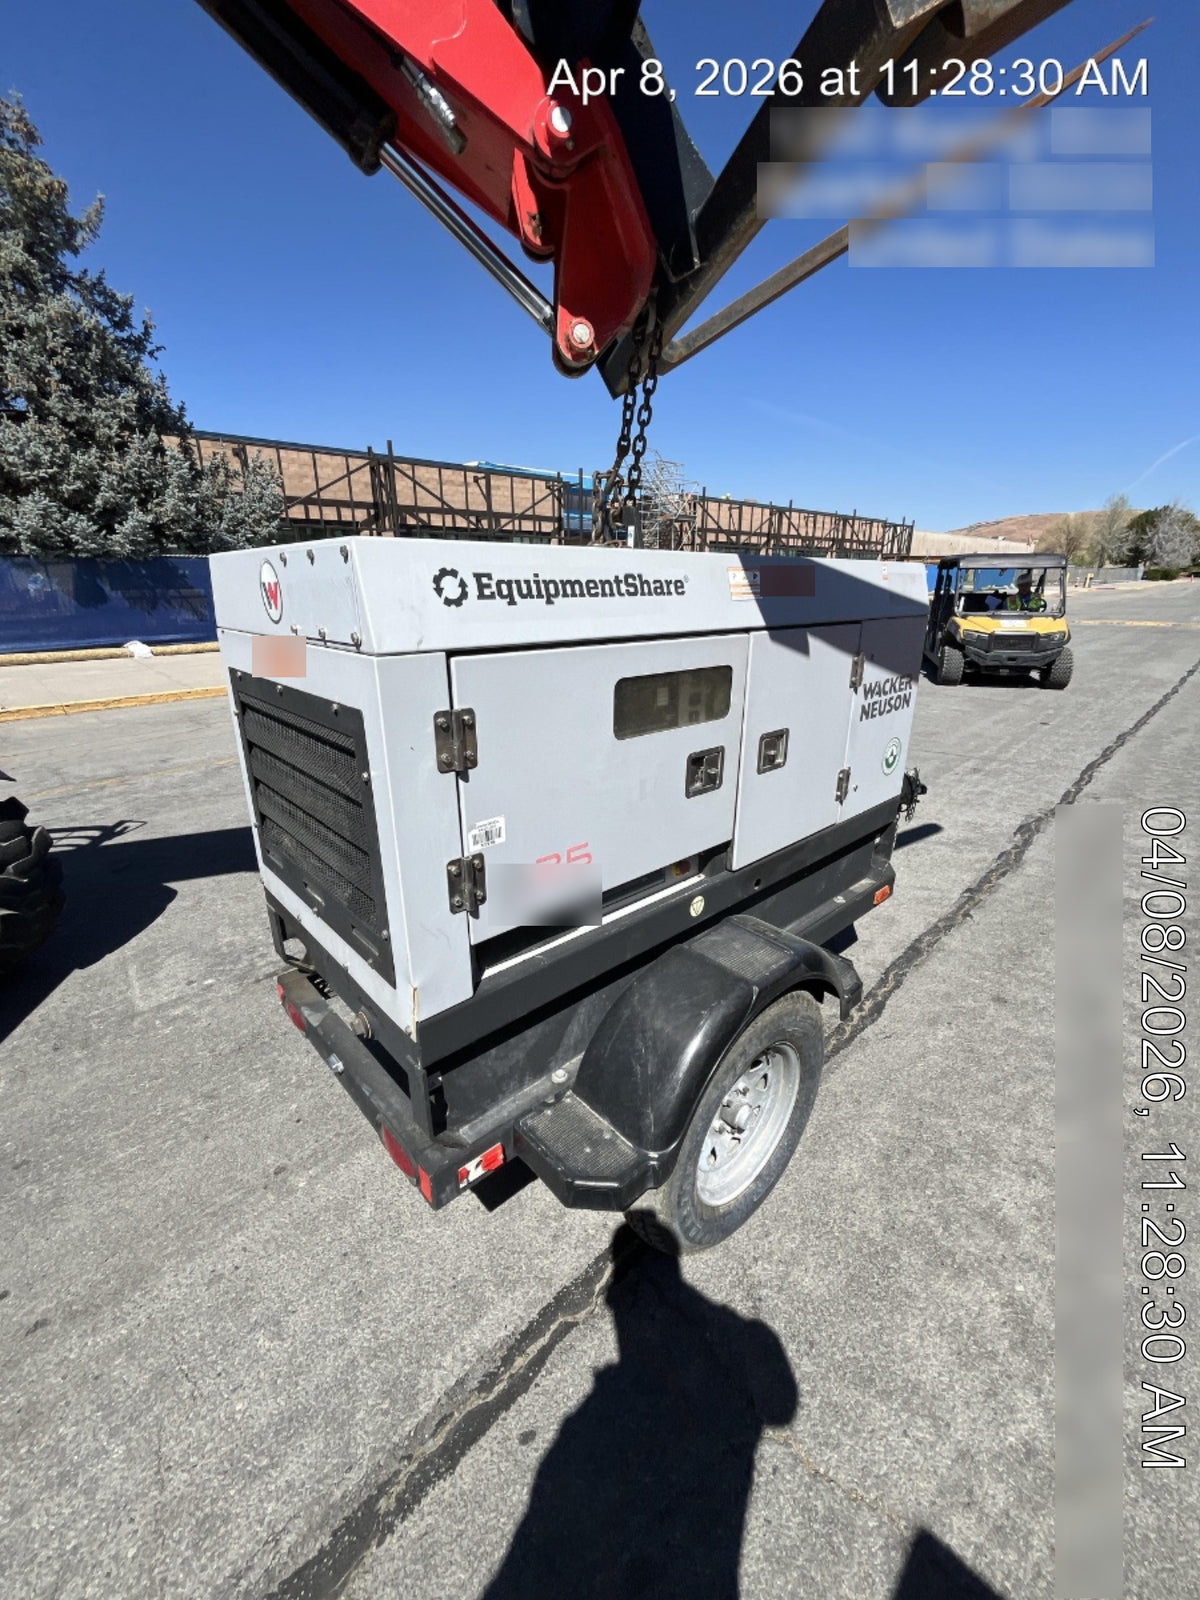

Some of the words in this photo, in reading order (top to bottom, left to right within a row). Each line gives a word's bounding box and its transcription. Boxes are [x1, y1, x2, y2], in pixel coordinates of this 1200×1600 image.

[472, 572, 686, 606] EquipmentShare
[863, 675, 913, 701] WACKER
[859, 691, 912, 722] NEUSON
